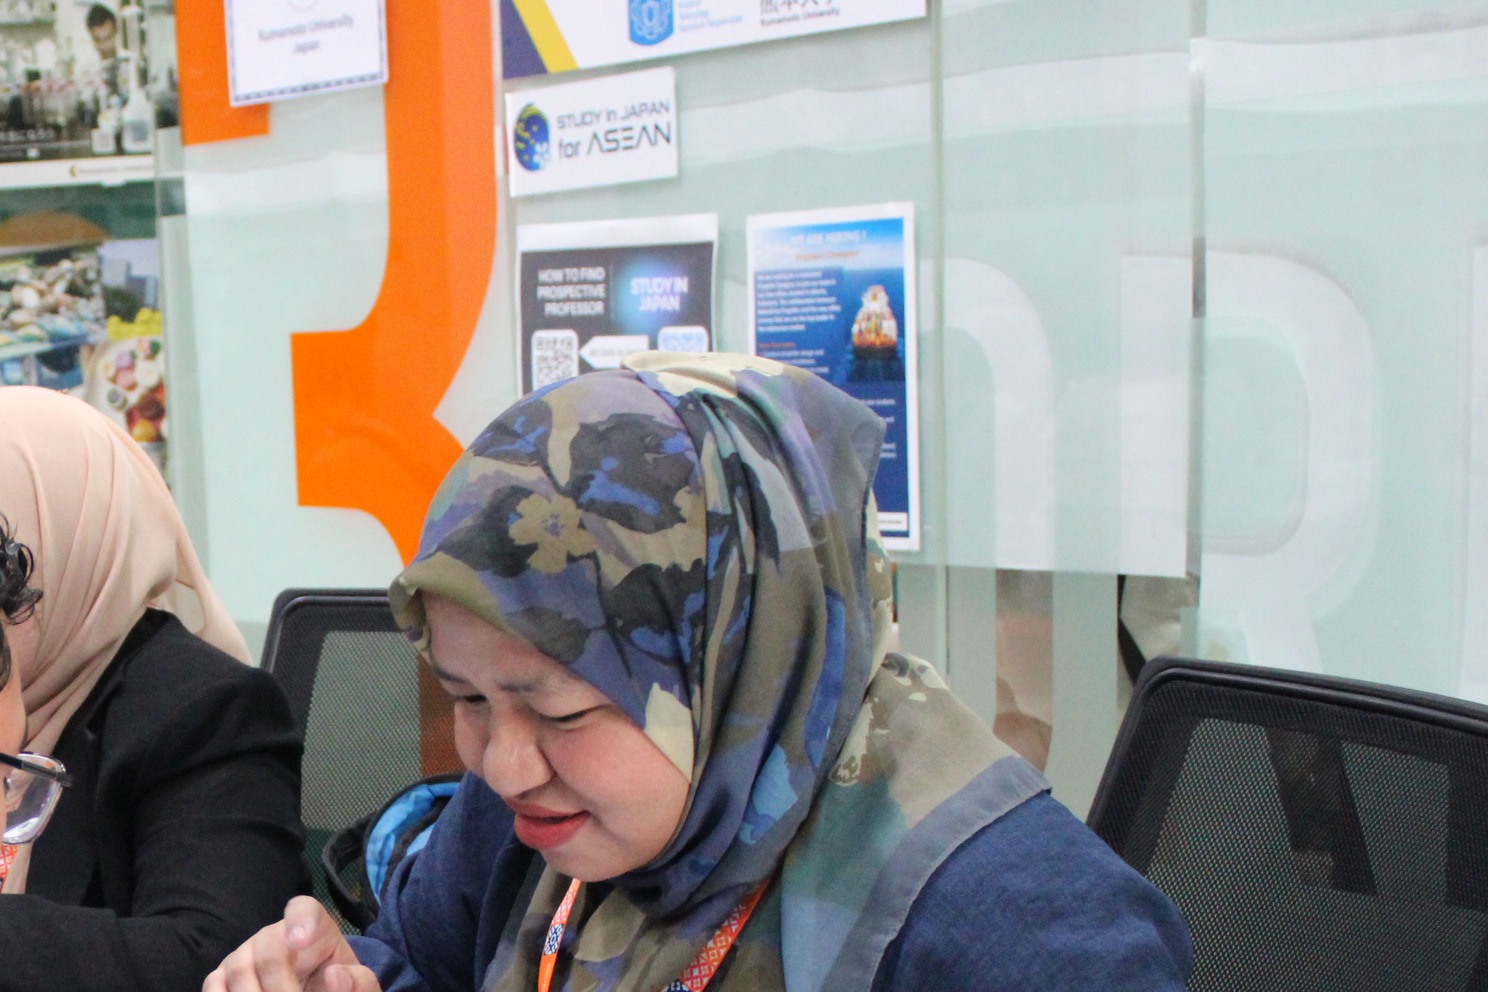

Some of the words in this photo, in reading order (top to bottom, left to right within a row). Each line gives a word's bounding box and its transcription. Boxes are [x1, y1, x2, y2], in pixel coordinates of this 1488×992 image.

[557, 109, 601, 129] STUDY
[621, 99, 670, 119] JAPAN
[559, 140, 581, 158] for
[587, 121, 671, 155] ASEAN
[538, 268, 564, 283] HOW
[564, 267, 579, 282] TO
[580, 266, 606, 281] FIND
[537, 284, 606, 300] PROSPECTIVE
[630, 277, 672, 295] STUDY
[672, 276, 689, 293] IN
[544, 301, 605, 317] PROFESSOR
[639, 295, 680, 312] JAPAN
